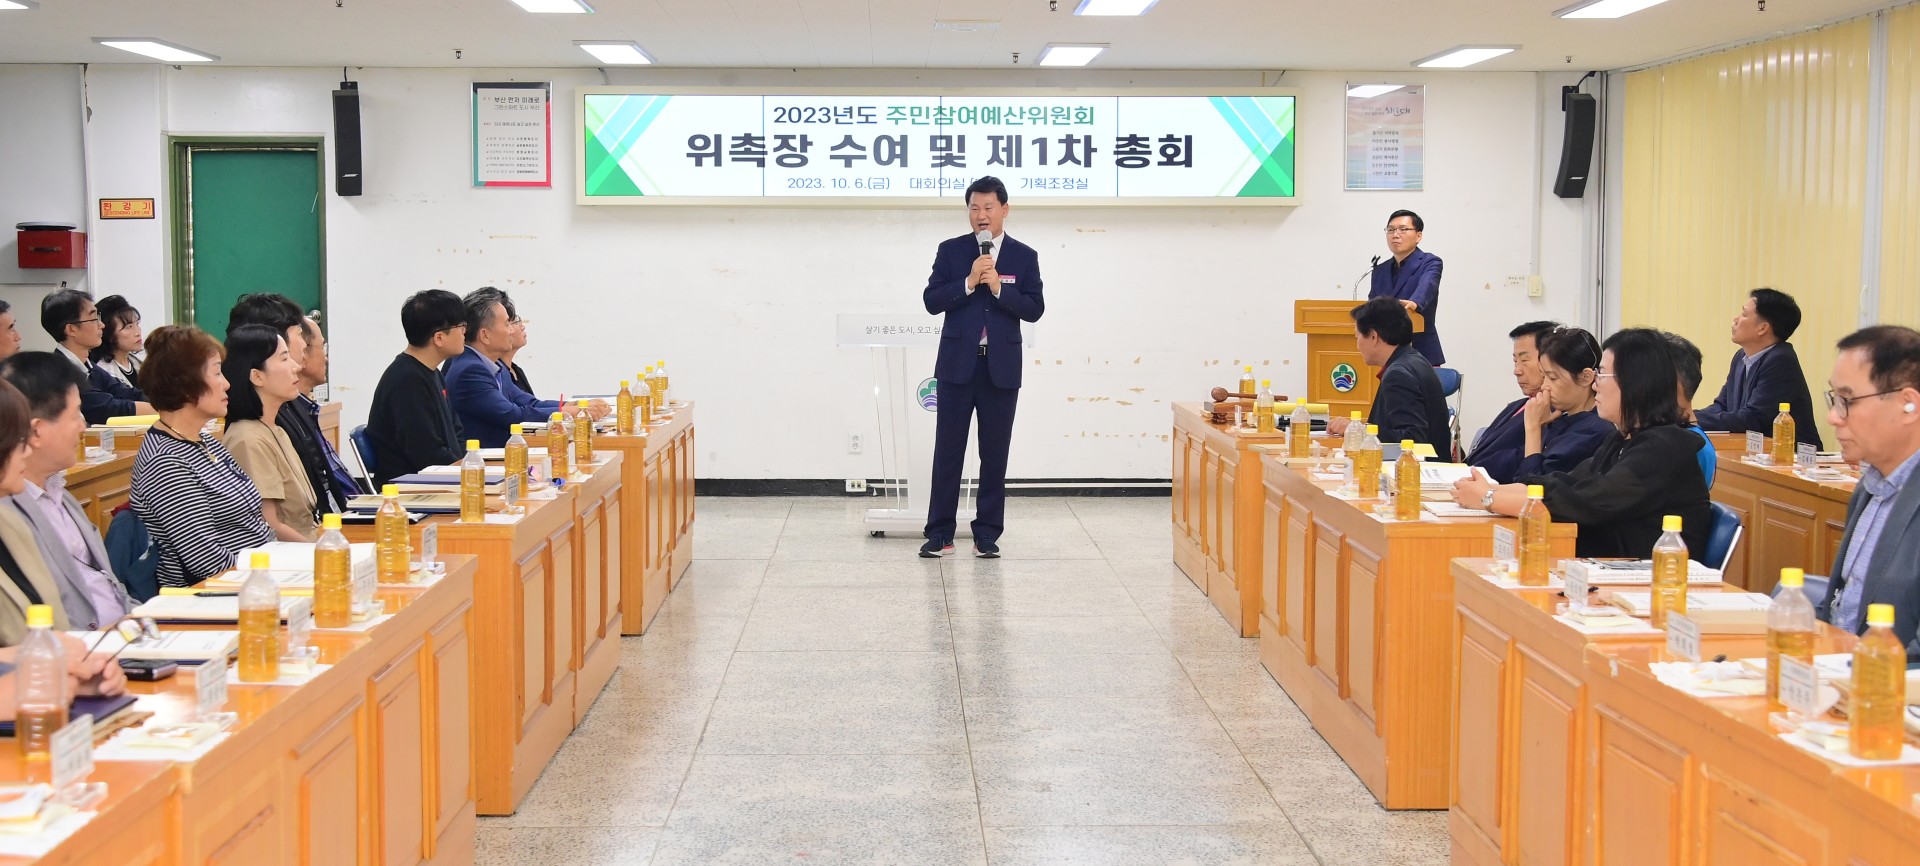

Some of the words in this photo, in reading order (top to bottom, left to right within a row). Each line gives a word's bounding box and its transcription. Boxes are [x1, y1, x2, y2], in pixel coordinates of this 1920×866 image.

[774, 106, 878, 125] 2023년도
[886, 106, 1094, 126] 주민참여예산위원회
[686, 134, 814, 168] 위촉장
[829, 134, 908, 168] 수여
[929, 134, 967, 168] 및
[986, 134, 1098, 168] 제1차
[1113, 134, 1193, 168] 총회
[787, 177, 825, 190] 2023.
[831, 177, 851, 190] 10.
[854, 176, 891, 190] 6.(금)
[909, 177, 965, 190] 대회의실
[1020, 177, 1089, 190] 기획조정실
[865, 325, 880, 335] 살기
[882, 325, 897, 335] 좋은
[899, 326, 915, 336] 도시,
[917, 325, 932, 334] 오고
